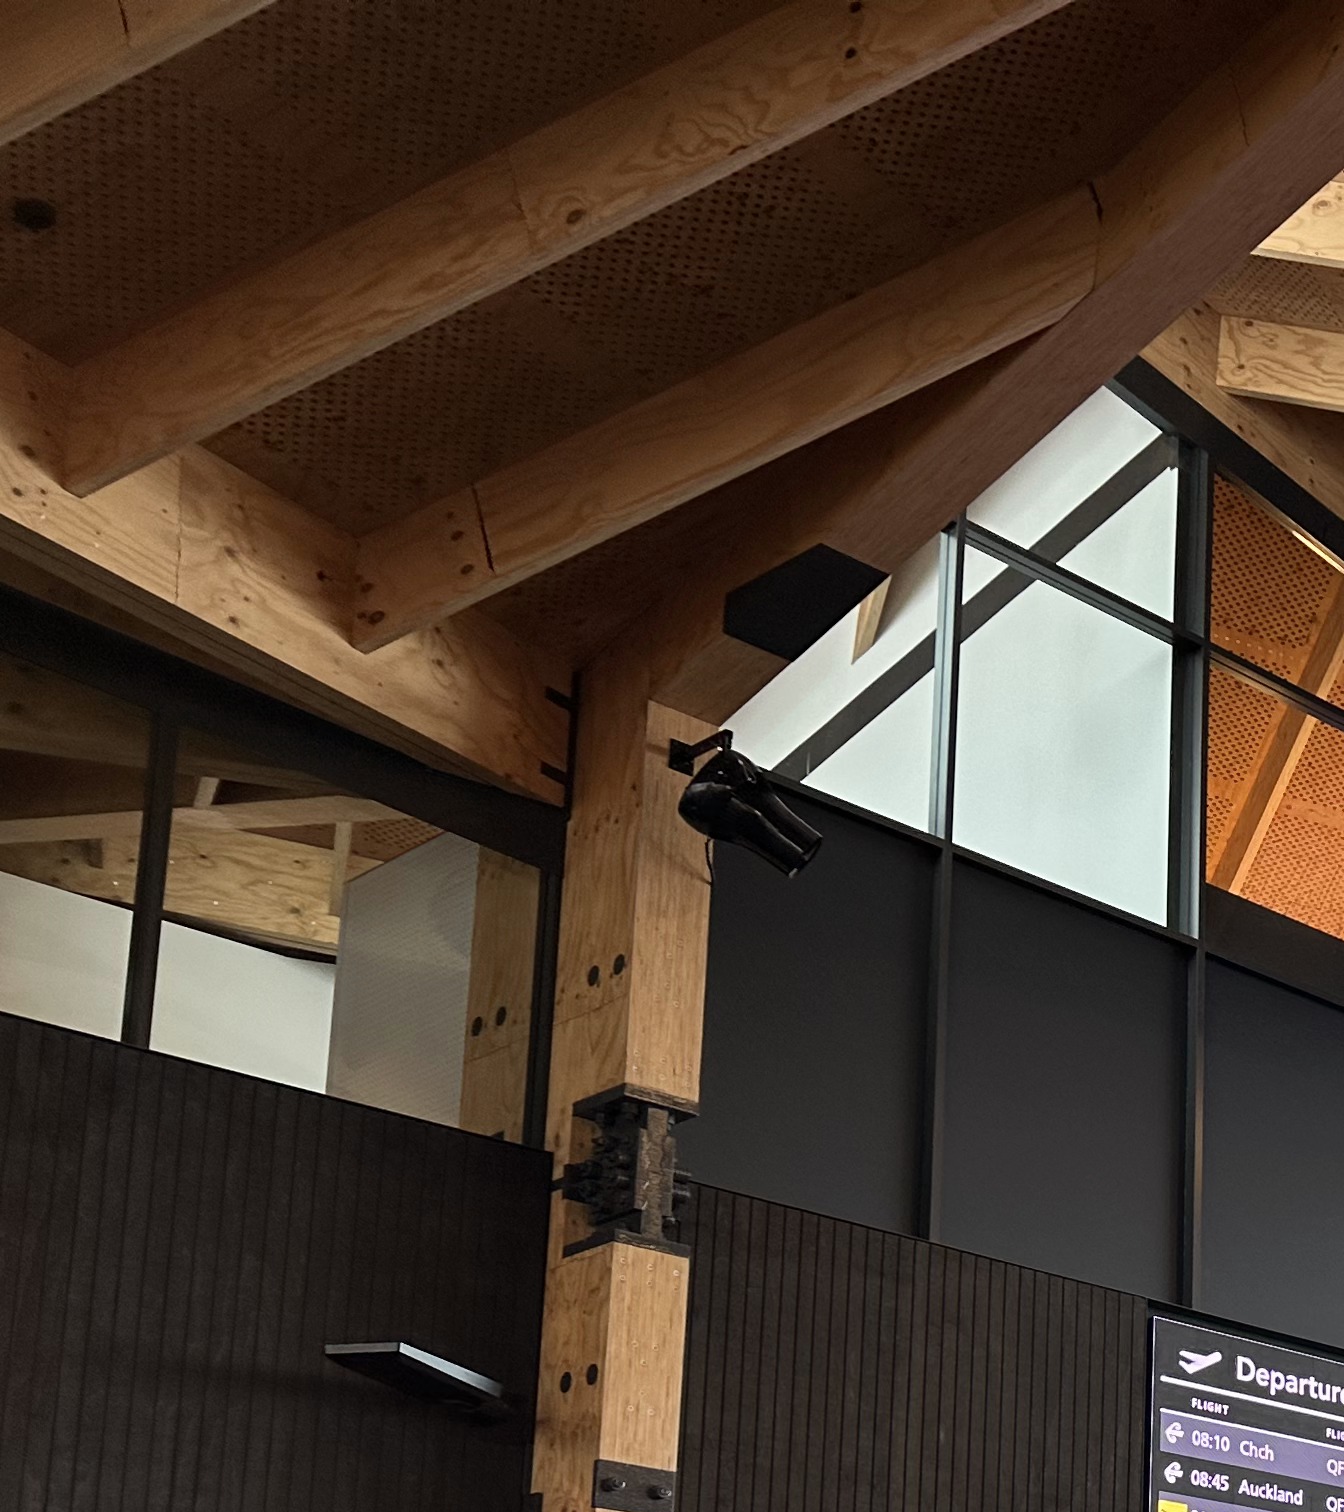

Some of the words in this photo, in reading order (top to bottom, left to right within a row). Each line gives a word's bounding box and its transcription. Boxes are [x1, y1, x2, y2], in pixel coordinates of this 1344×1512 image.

[1191, 1398, 1230, 1415] FLIGHT
[1192, 1430, 1230, 1451] 08:10
[1239, 1441, 1274, 1461] Chch
[1191, 1469, 1230, 1491] 08:45
[1238, 1479, 1303, 1505] Auckland
